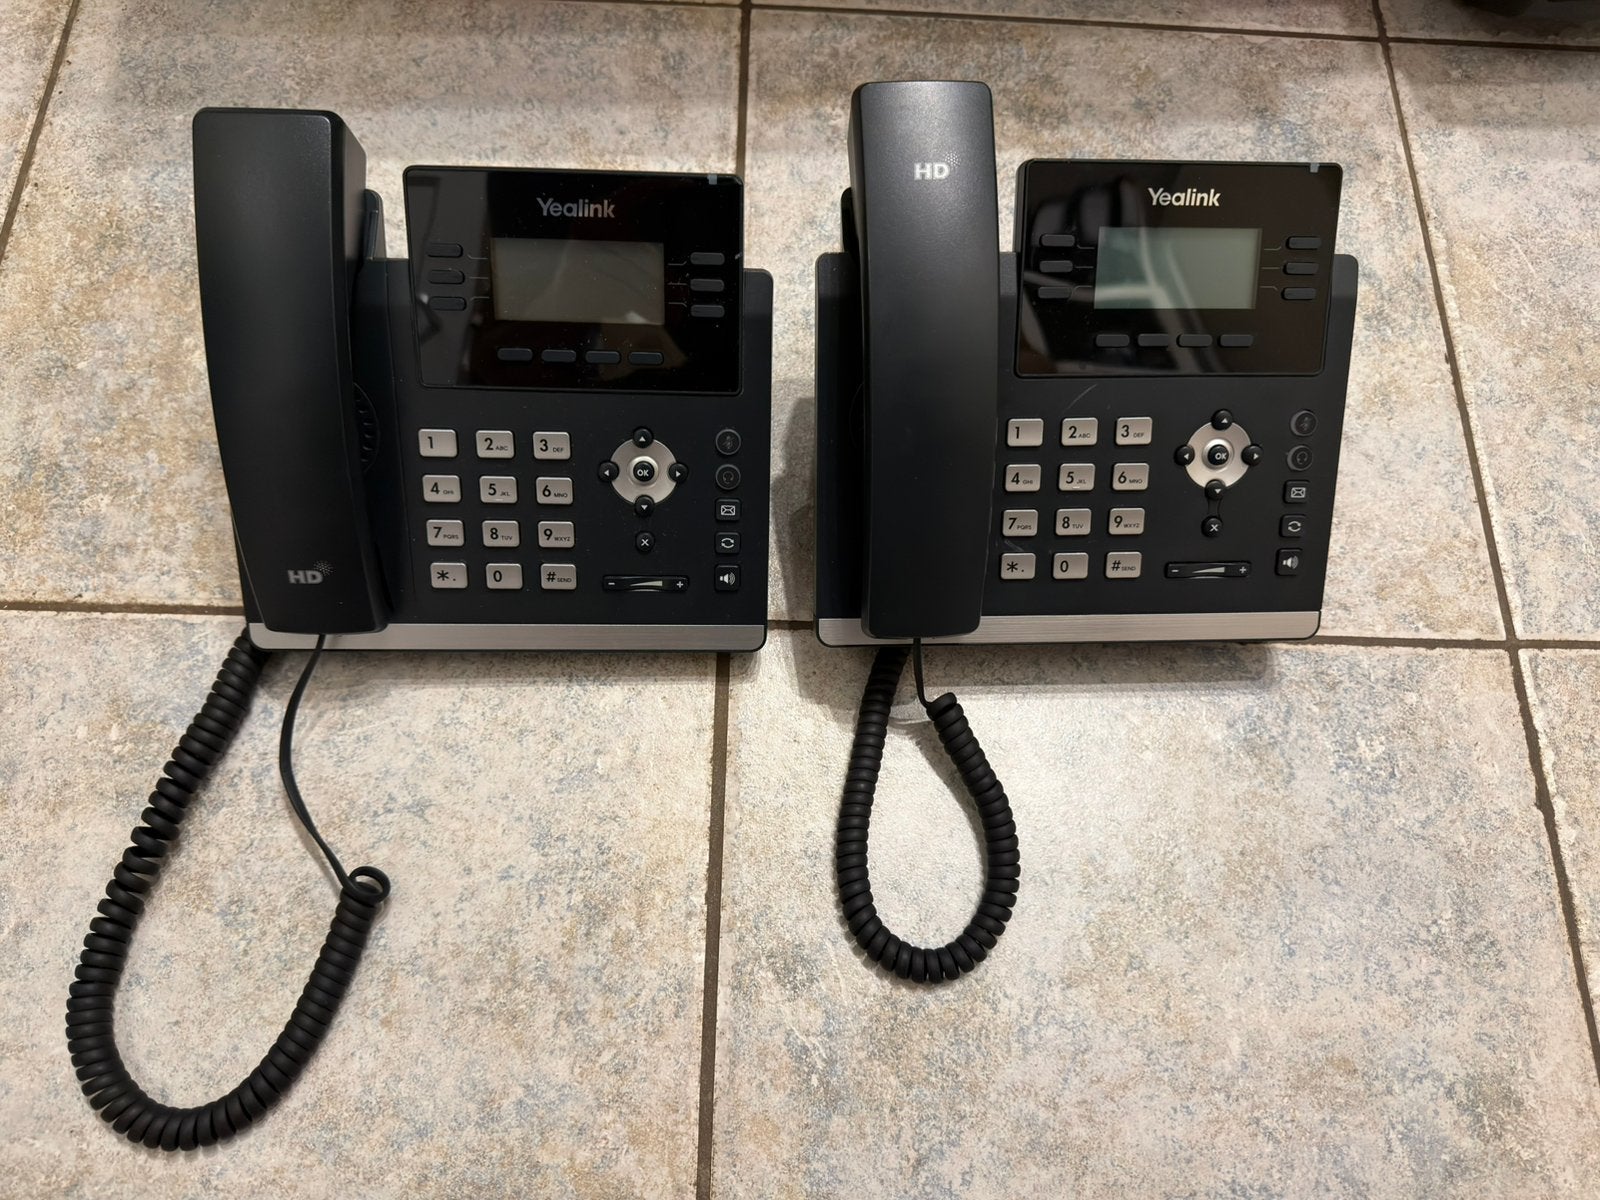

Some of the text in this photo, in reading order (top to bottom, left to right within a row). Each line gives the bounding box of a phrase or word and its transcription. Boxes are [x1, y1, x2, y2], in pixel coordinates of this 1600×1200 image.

[914, 162, 950, 181] HD
[1148, 187, 1222, 207] Yealink
[536, 197, 616, 219] Yealink
[1014, 426, 1021, 439] 1
[1068, 426, 1077, 439] 2
[1122, 425, 1130, 438] 3
[427, 436, 434, 449] 1
[484, 438, 494, 451] 2
[539, 439, 548, 452] 3
[1215, 452, 1227, 461] OK
[637, 469, 650, 477] OK
[1011, 472, 1020, 485] 4
[1066, 472, 1074, 484] 5
[1118, 472, 1126, 484] 6
[430, 482, 440, 494] 4
[488, 484, 497, 496] 5
[542, 485, 551, 498] 6
[1008, 518, 1017, 530] 7
[1062, 517, 1070, 529] 8
[1114, 515, 1123, 529] 9
[433, 527, 442, 538] 7
[490, 528, 499, 540] 8
[543, 529, 553, 541] 9
[1060, 561, 1069, 573] 0
[1111, 560, 1122, 571] #
[288, 570, 323, 584] HD
[493, 570, 502, 583] 0
[546, 572, 557, 582] #
